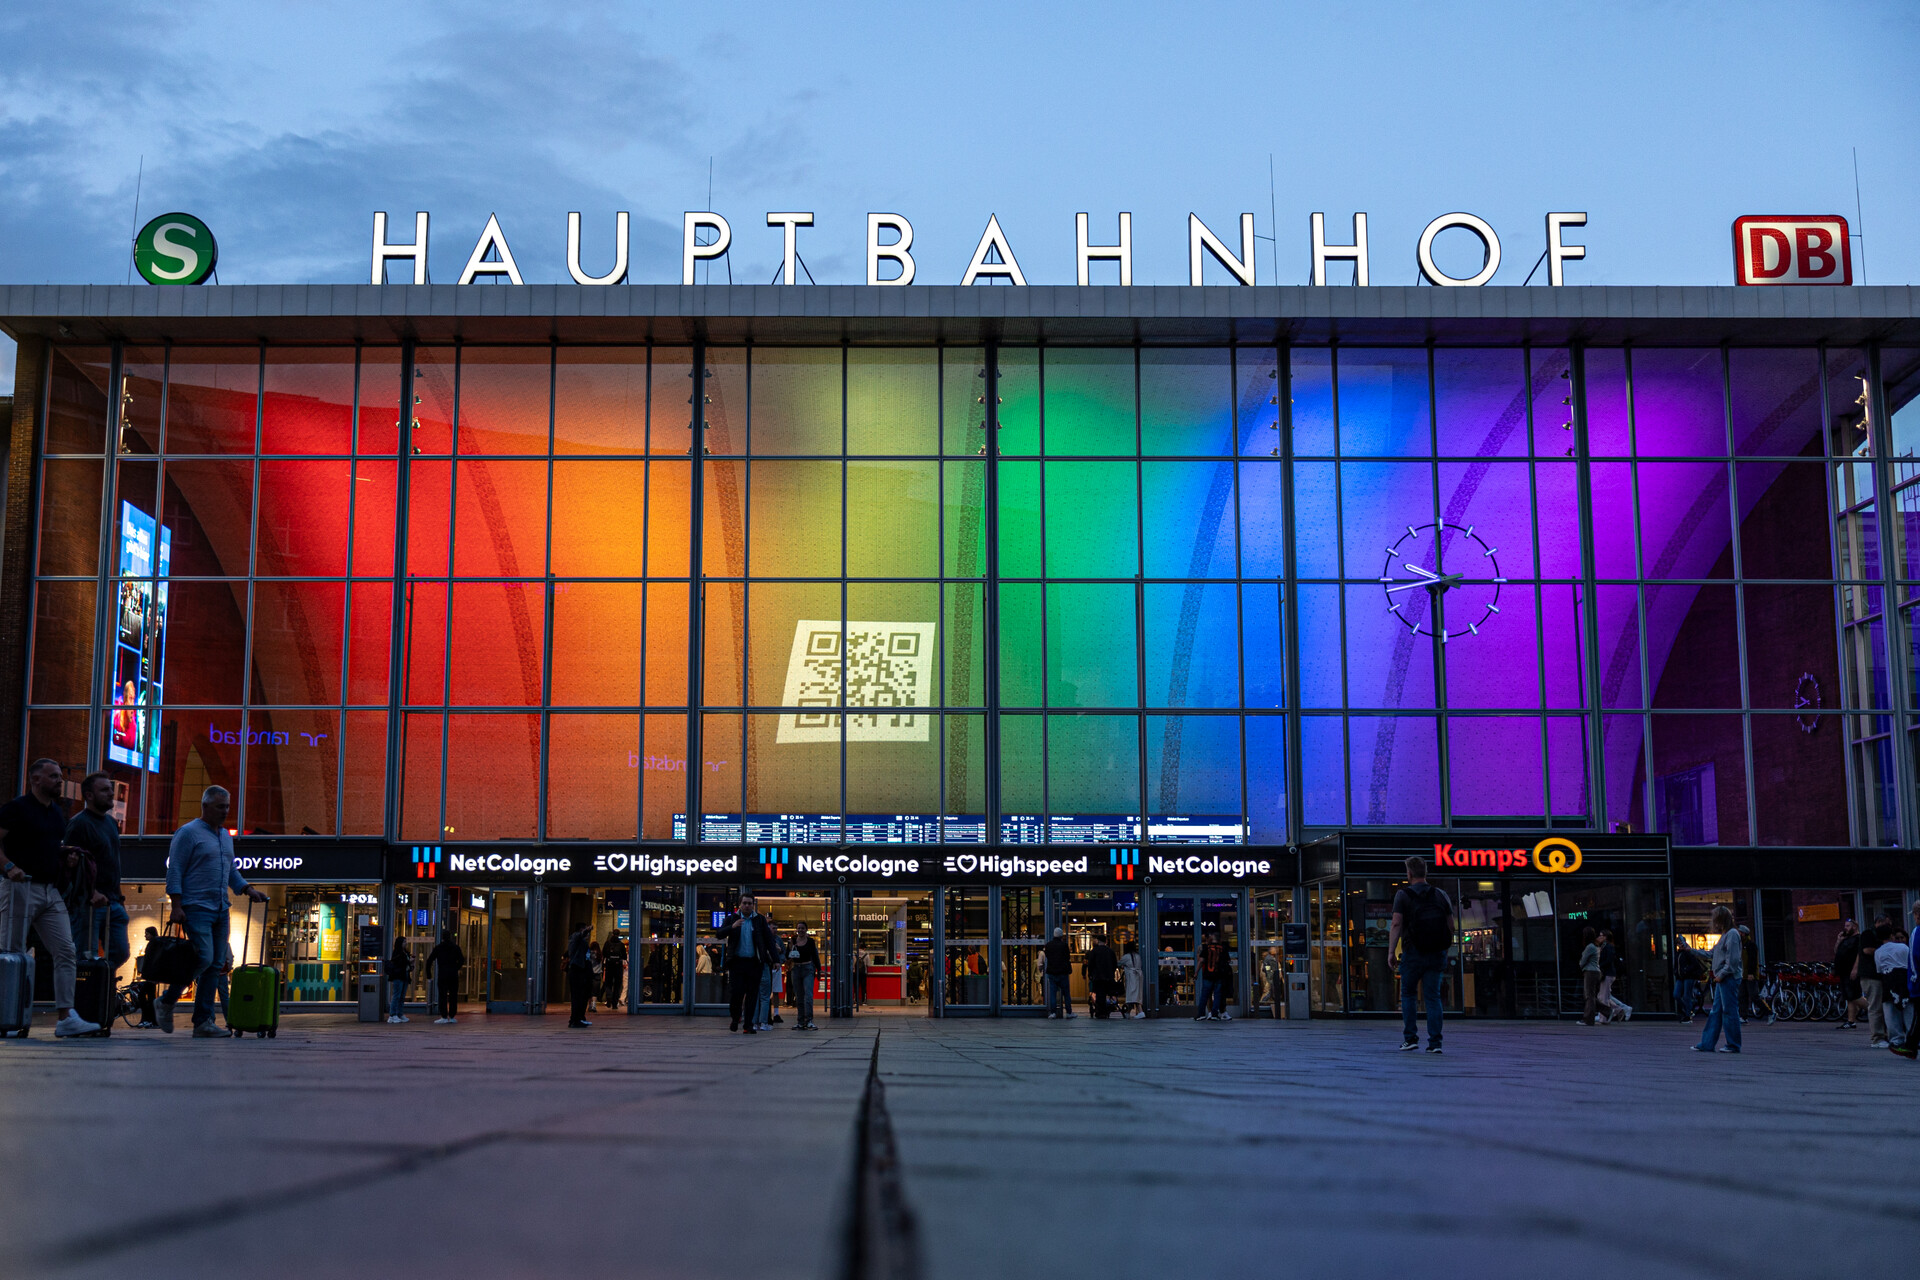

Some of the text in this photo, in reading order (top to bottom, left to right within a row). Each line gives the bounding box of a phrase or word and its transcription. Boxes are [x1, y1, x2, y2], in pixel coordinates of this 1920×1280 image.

[151, 222, 198, 280] S
[371, 211, 1588, 287] HAUPTBAHNHOF
[1749, 227, 1837, 279] DB
[233, 857, 303, 870] ODY SHOP
[450, 853, 572, 876] NetCologne
[630, 854, 738, 876] Highspeed
[798, 854, 919, 877] NetCologne
[979, 855, 1088, 877] Highspeed
[1148, 855, 1271, 878] NetCologne
[1434, 843, 1528, 872] Kamps
